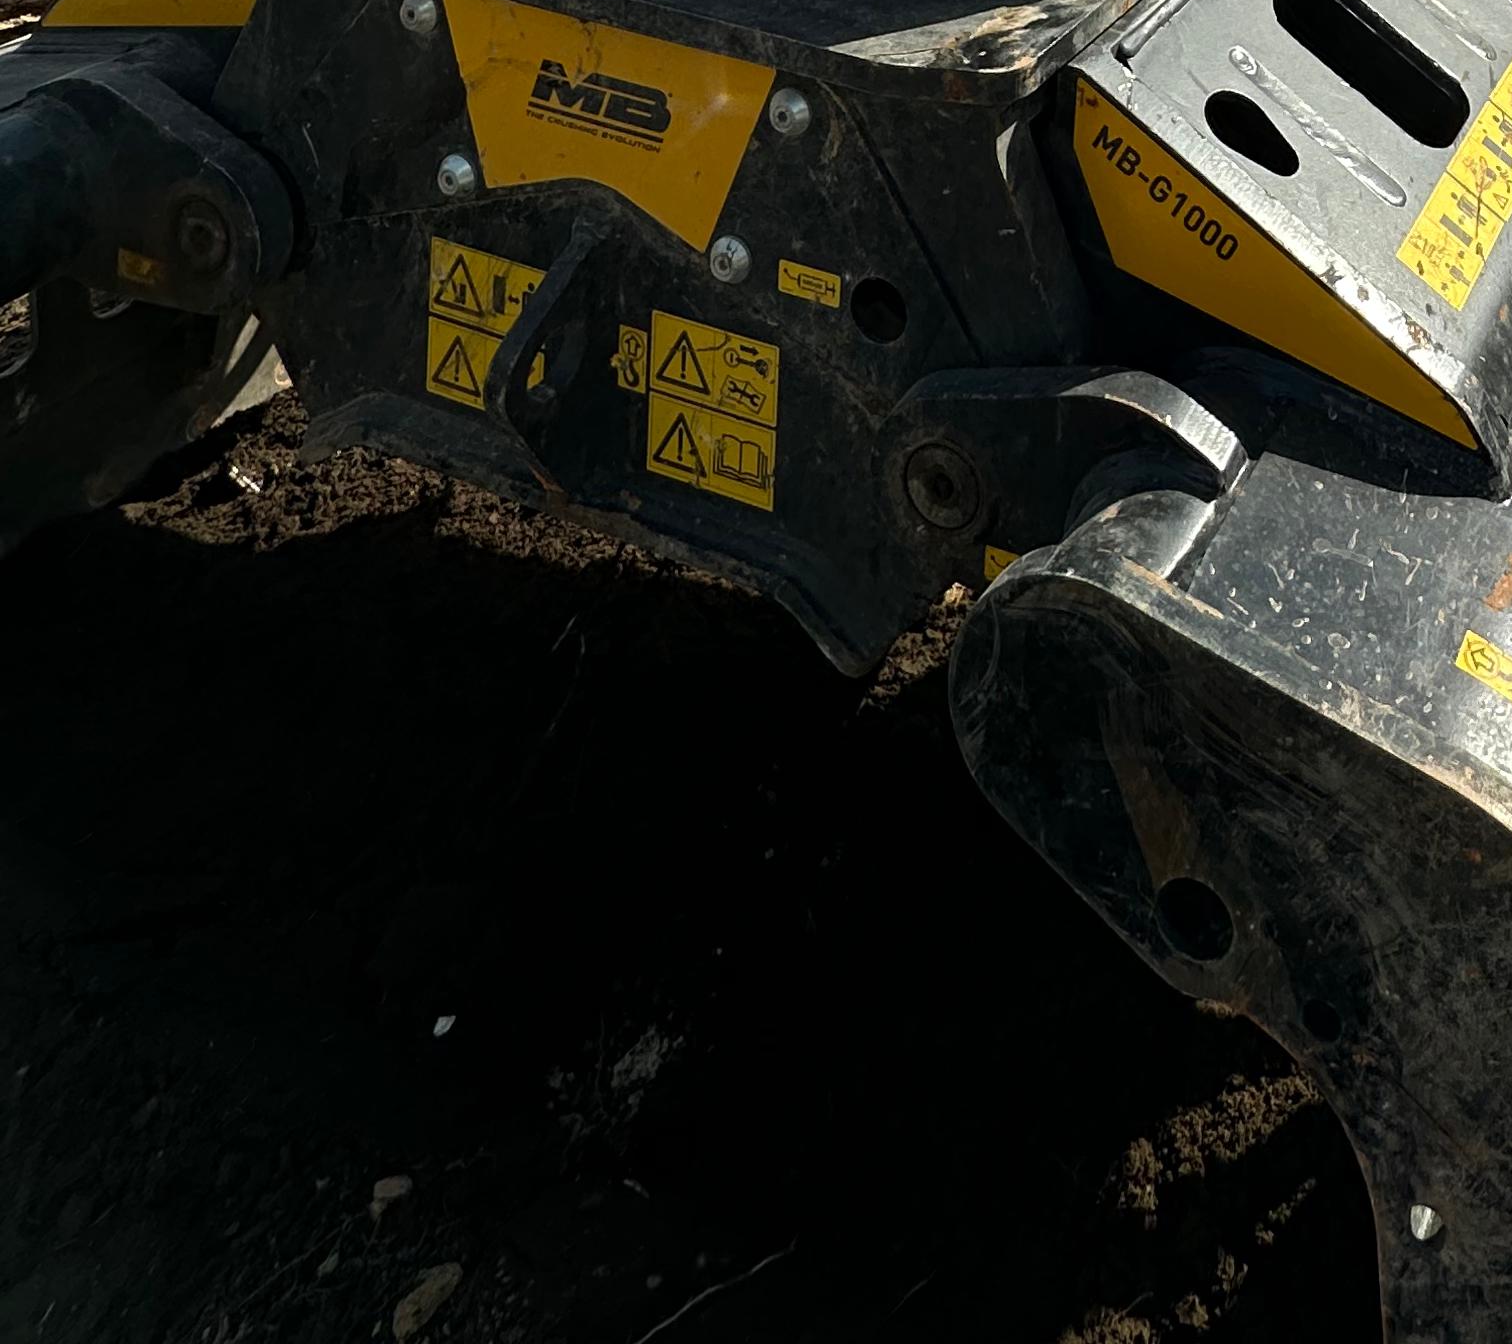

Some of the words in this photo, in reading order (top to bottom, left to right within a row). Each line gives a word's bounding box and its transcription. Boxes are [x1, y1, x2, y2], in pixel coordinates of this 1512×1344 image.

[526, 109, 545, 120] THE
[547, 116, 599, 137] CRUSHING
[601, 132, 661, 154] EVOLUTION
[531, 59, 672, 133] MB
[1092, 124, 1239, 261] MB-G1000
